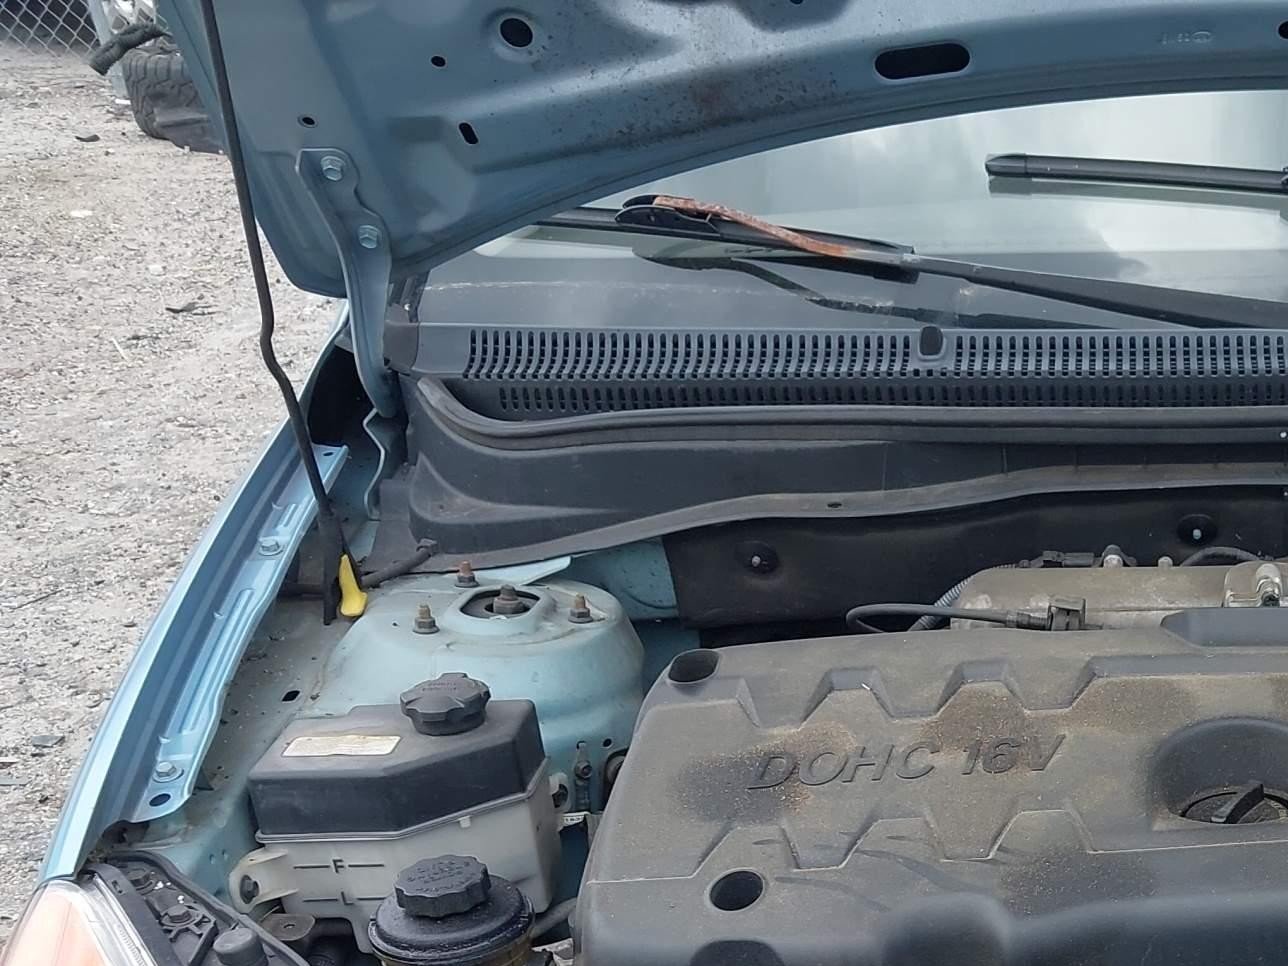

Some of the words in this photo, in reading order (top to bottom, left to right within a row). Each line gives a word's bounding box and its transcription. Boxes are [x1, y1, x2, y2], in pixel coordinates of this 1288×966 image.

[747, 741, 941, 791] DOHC
[963, 733, 1067, 777] 16V
[332, 858, 345, 874] F
[340, 890, 354, 906] L
